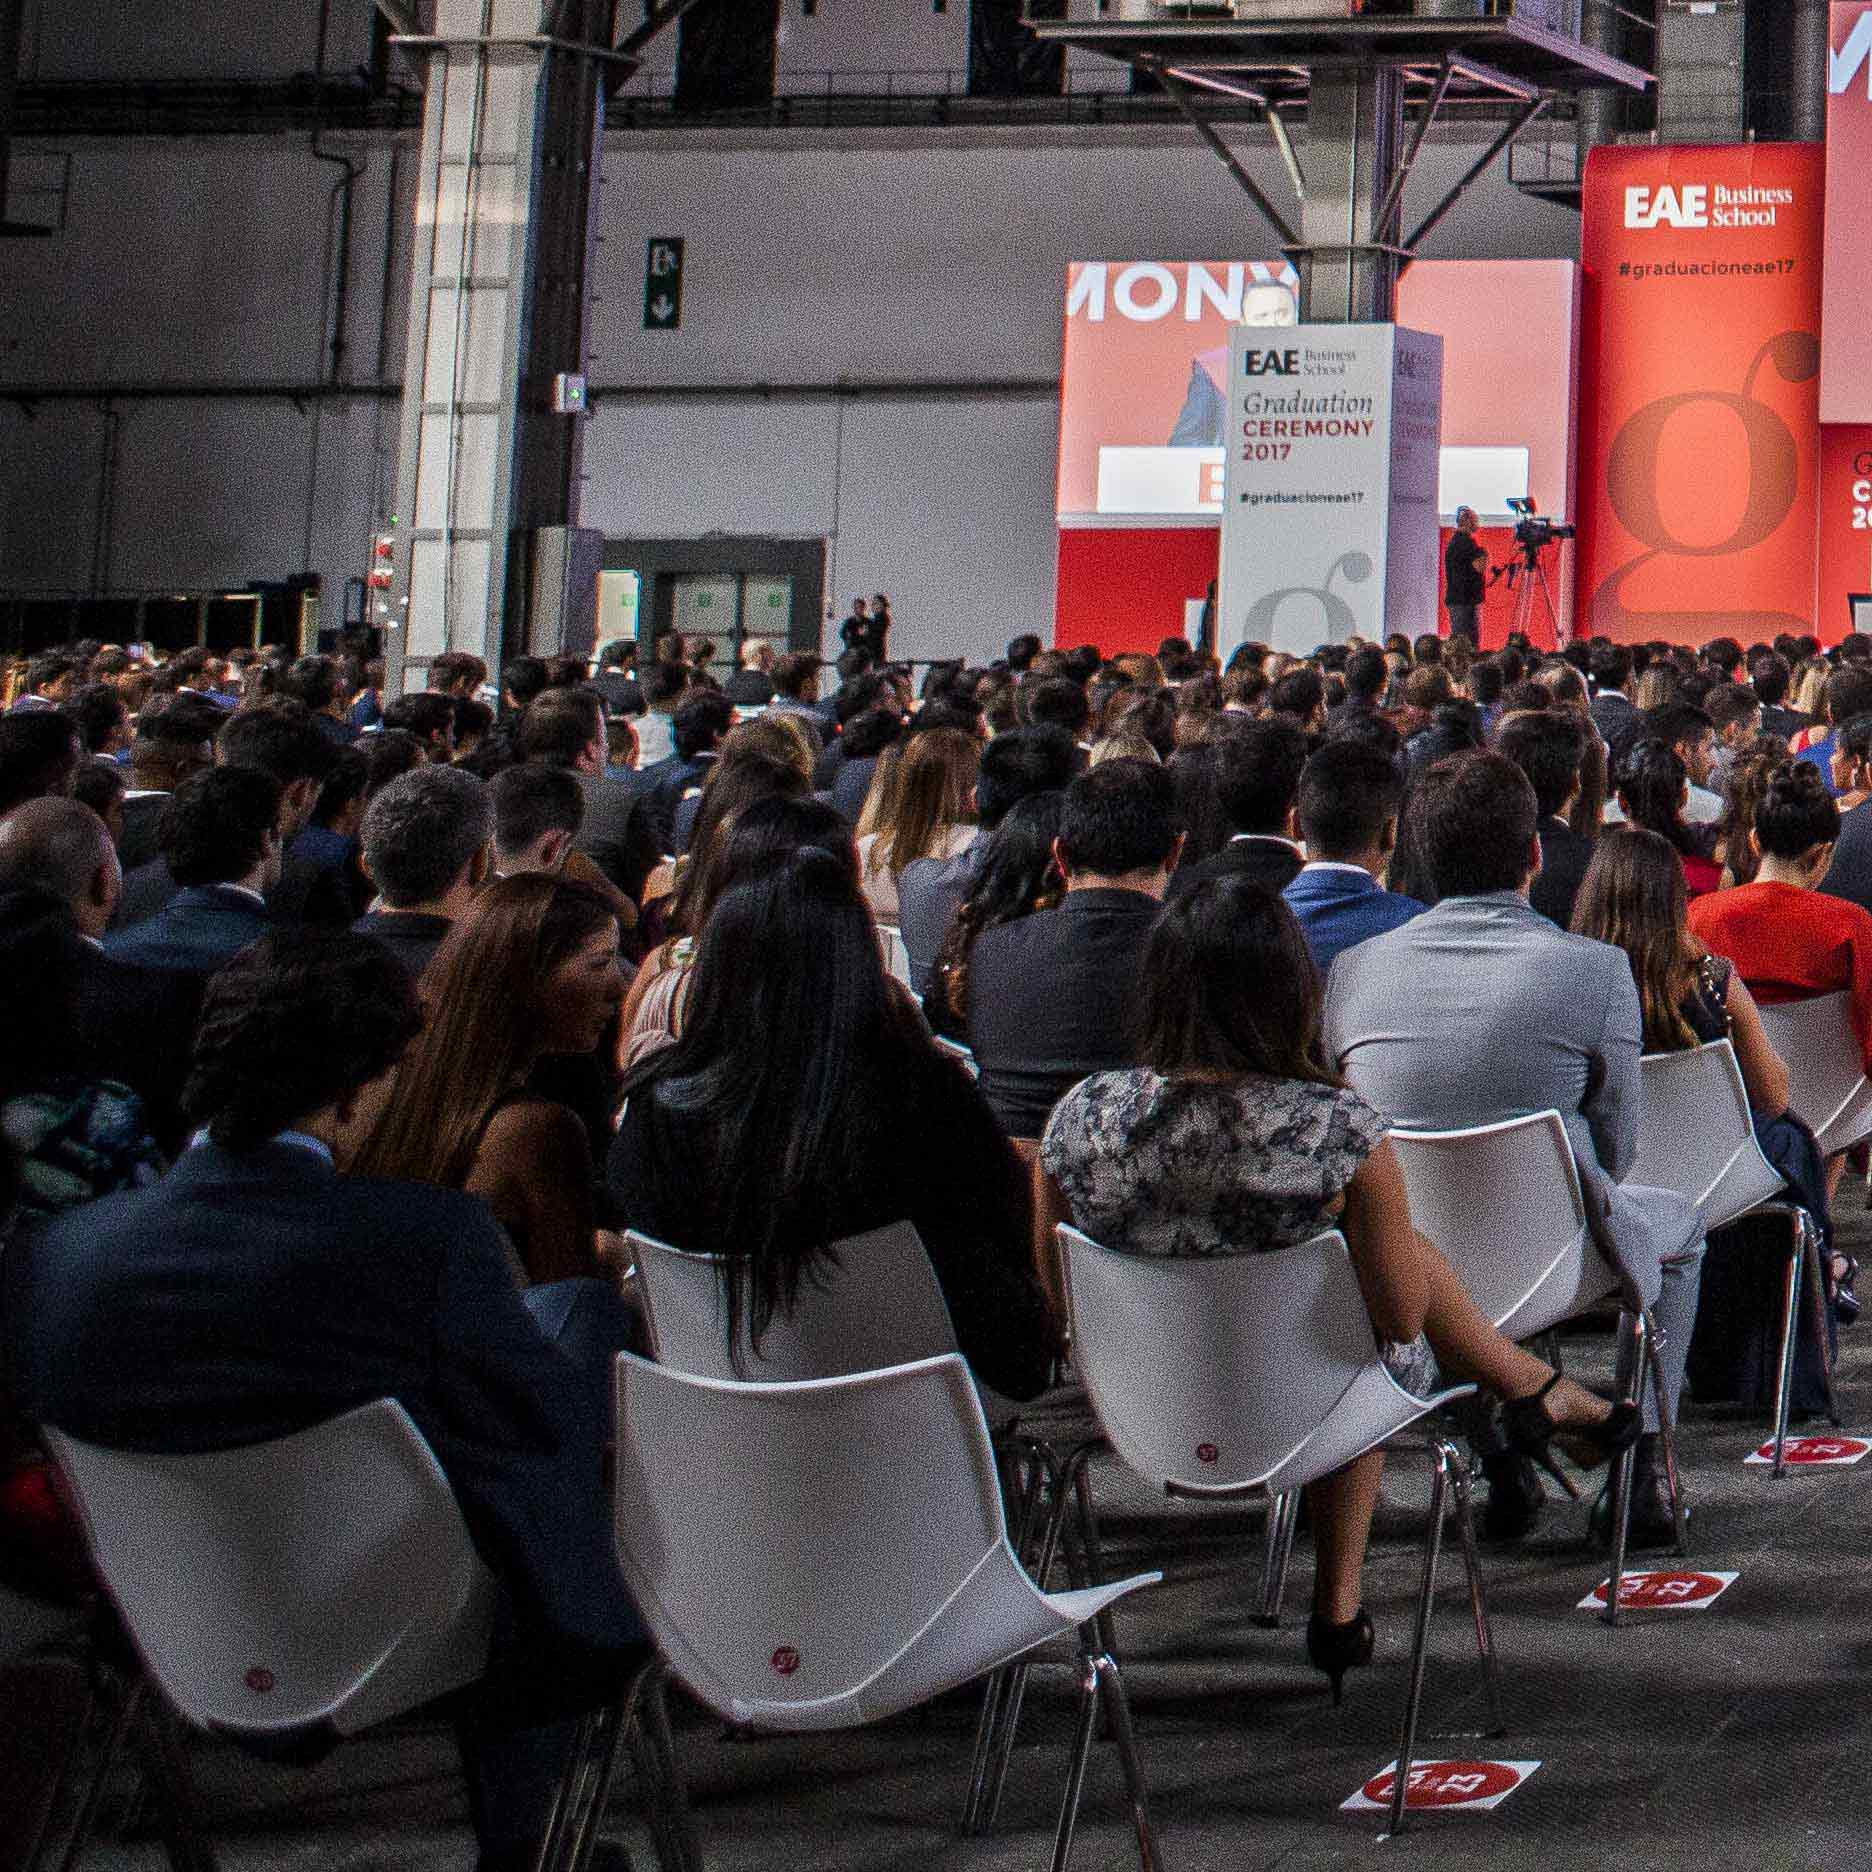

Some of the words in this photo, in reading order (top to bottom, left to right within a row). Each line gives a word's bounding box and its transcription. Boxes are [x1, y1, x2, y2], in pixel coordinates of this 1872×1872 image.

[1624, 185, 1709, 228] EAE
[1714, 184, 1793, 204] Business
[1712, 206, 1776, 227] School
[1618, 259, 1795, 280] #graduacioneae17
[1245, 349, 1300, 376] EAE
[1243, 389, 1373, 415] Graduation
[1242, 419, 1375, 438] CEREMONY
[1242, 442, 1292, 461] 2017
[1240, 492, 1364, 506] #graduacioneae17
[1437, 1773, 1487, 1793] 23
